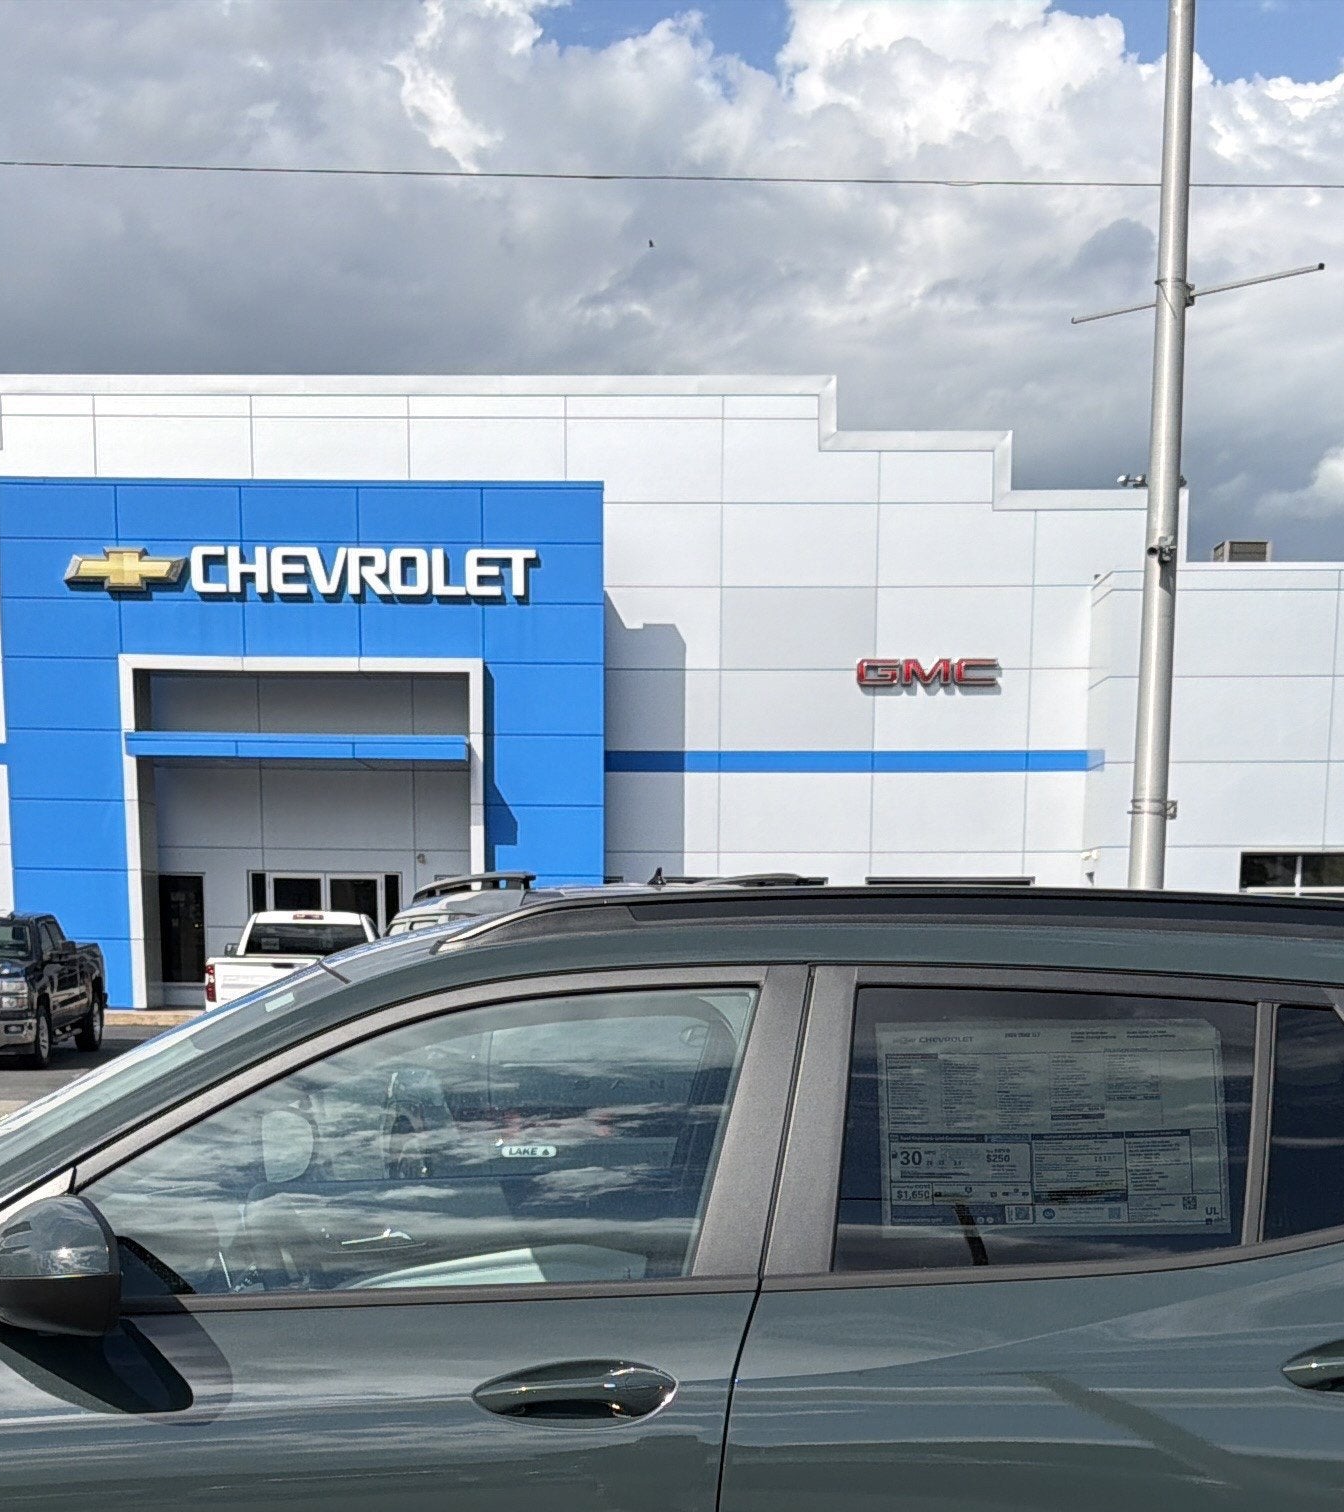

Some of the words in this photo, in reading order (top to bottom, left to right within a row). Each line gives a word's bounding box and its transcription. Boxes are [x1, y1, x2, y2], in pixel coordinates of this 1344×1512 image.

[190, 546, 537, 597] CHEVROLET
[856, 658, 999, 687] GMC
[509, 1147, 538, 1156] LAKE
[900, 1151, 922, 1166] 30
